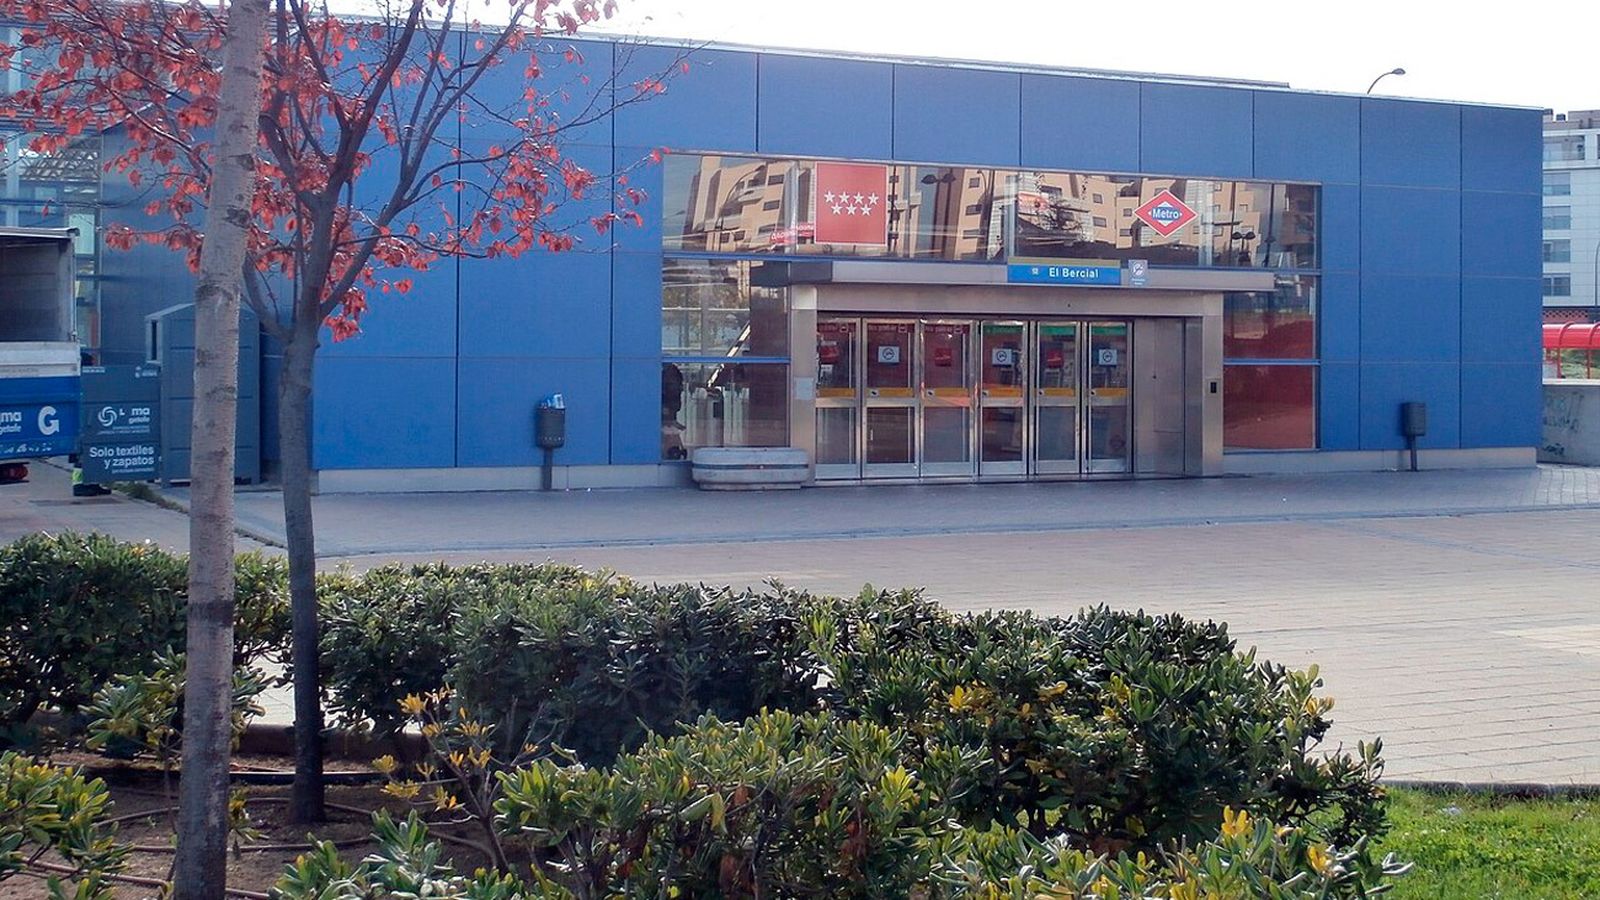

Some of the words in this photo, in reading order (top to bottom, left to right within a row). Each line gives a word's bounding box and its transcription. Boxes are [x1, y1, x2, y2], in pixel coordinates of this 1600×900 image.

[1152, 208, 1179, 219] Metro
[1049, 267, 1059, 277] El
[1062, 267, 1099, 278] Bercial
[0, 411, 22, 423] ma
[89, 446, 115, 458] Solo
[116, 445, 154, 457] textiles
[104, 459, 111, 470] y
[112, 456, 155, 468] zapatos
